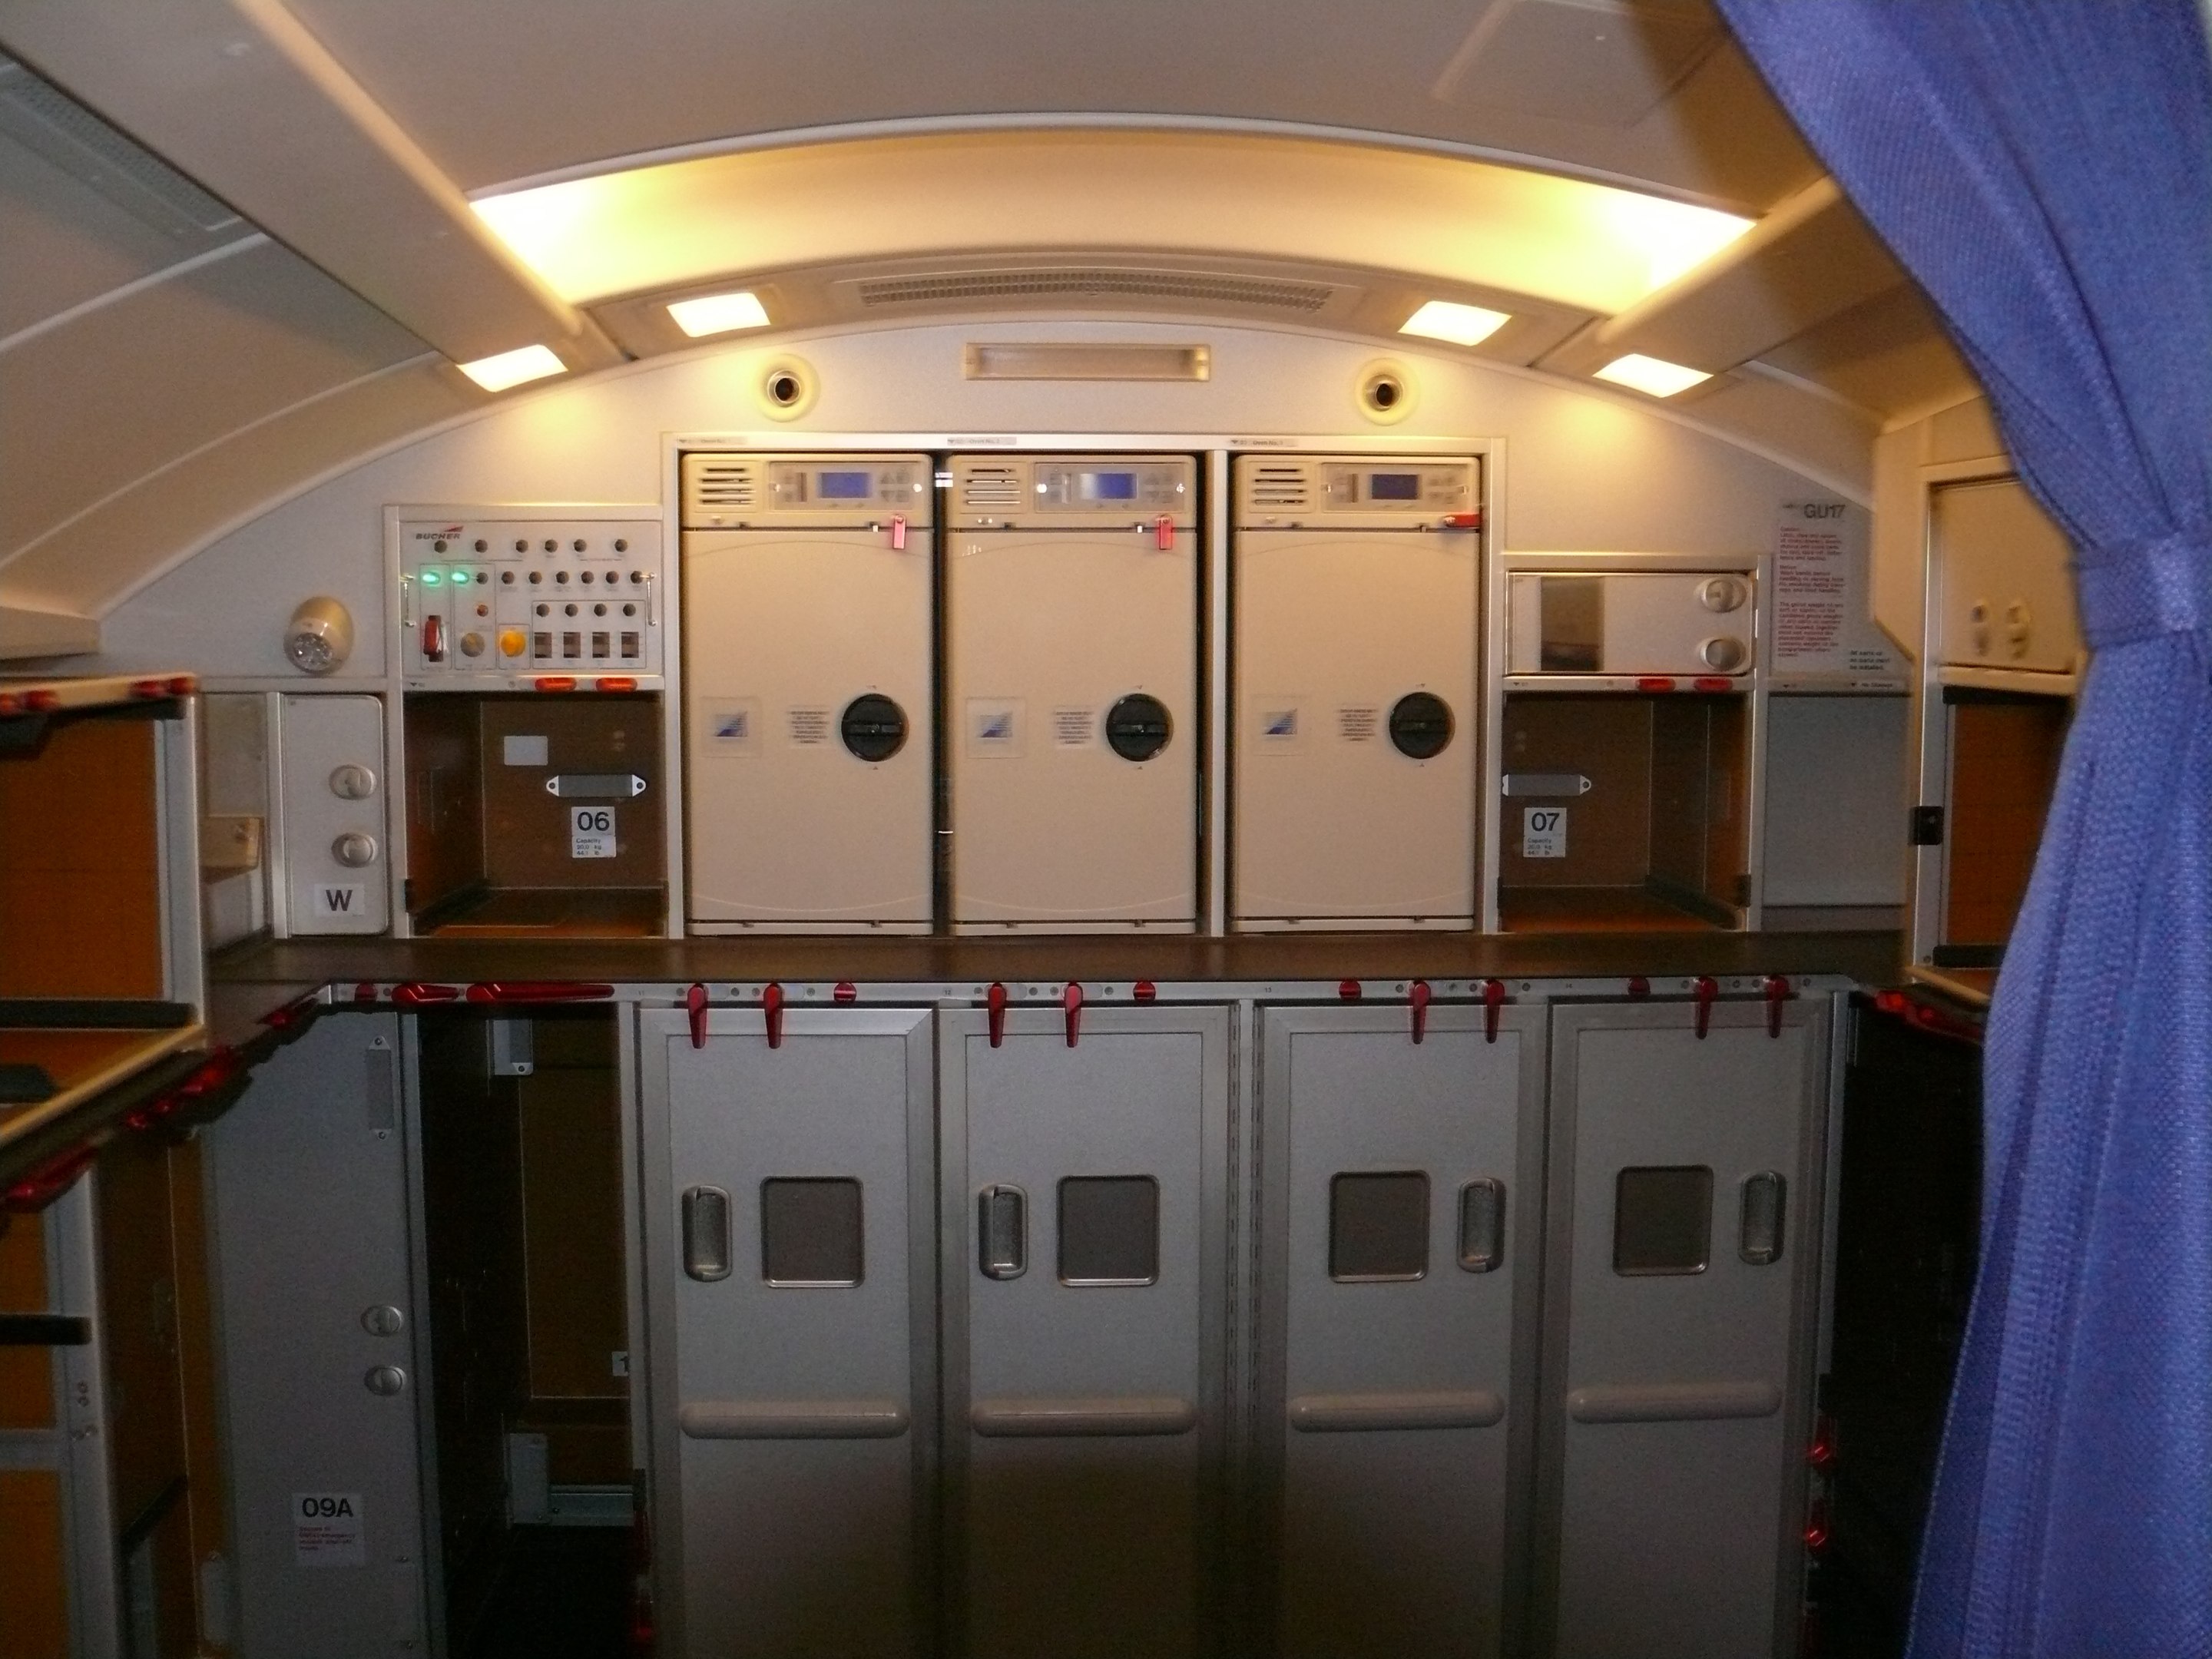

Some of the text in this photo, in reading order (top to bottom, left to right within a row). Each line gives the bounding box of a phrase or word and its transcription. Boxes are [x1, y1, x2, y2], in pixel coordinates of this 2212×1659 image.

[1805, 504, 1846, 518] GU17
[578, 812, 609, 831] 06
[1532, 812, 1559, 831] 07
[326, 889, 353, 911] W
[302, 1498, 353, 1518] 09A
